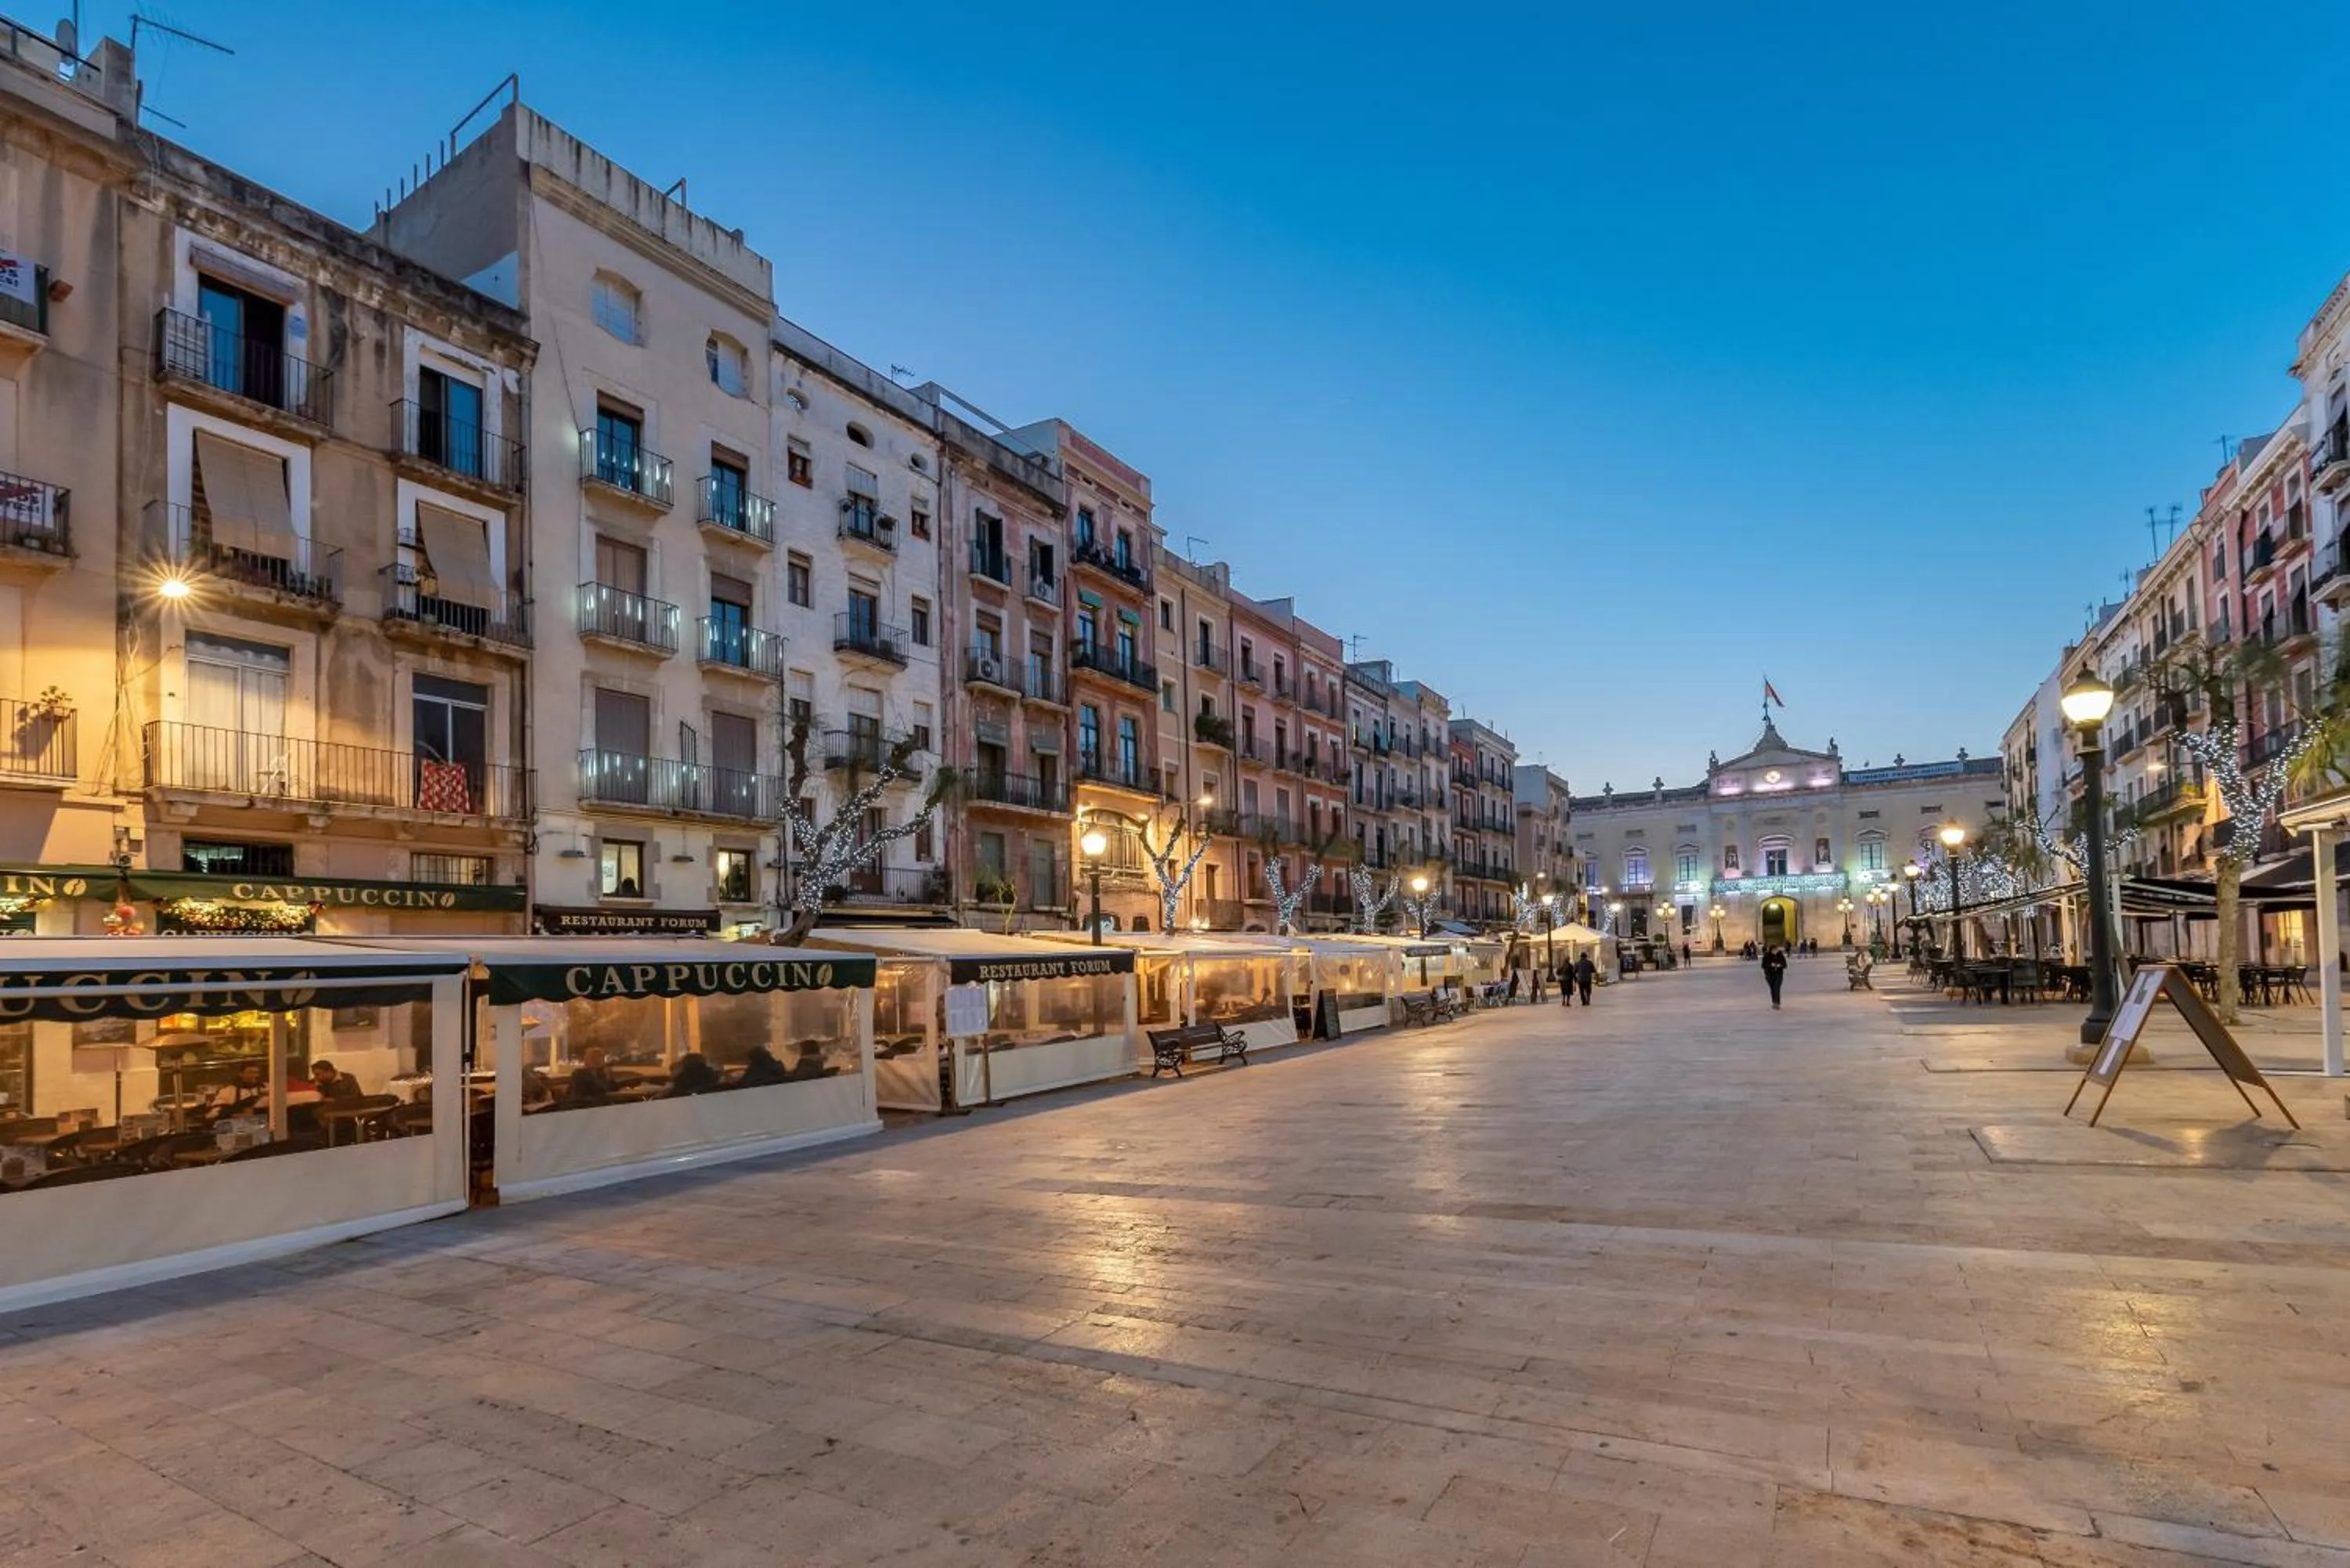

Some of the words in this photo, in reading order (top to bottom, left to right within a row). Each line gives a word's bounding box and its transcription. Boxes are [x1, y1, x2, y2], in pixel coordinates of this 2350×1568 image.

[232, 883, 456, 909] CAPPUCCINO
[561, 916, 655, 927] RESTAURANT
[660, 917, 708, 929] FORUM
[565, 962, 833, 995] CAPPUCCINO
[979, 961, 1065, 979] RESTAURANT
[1070, 959, 1112, 974] FORUM
